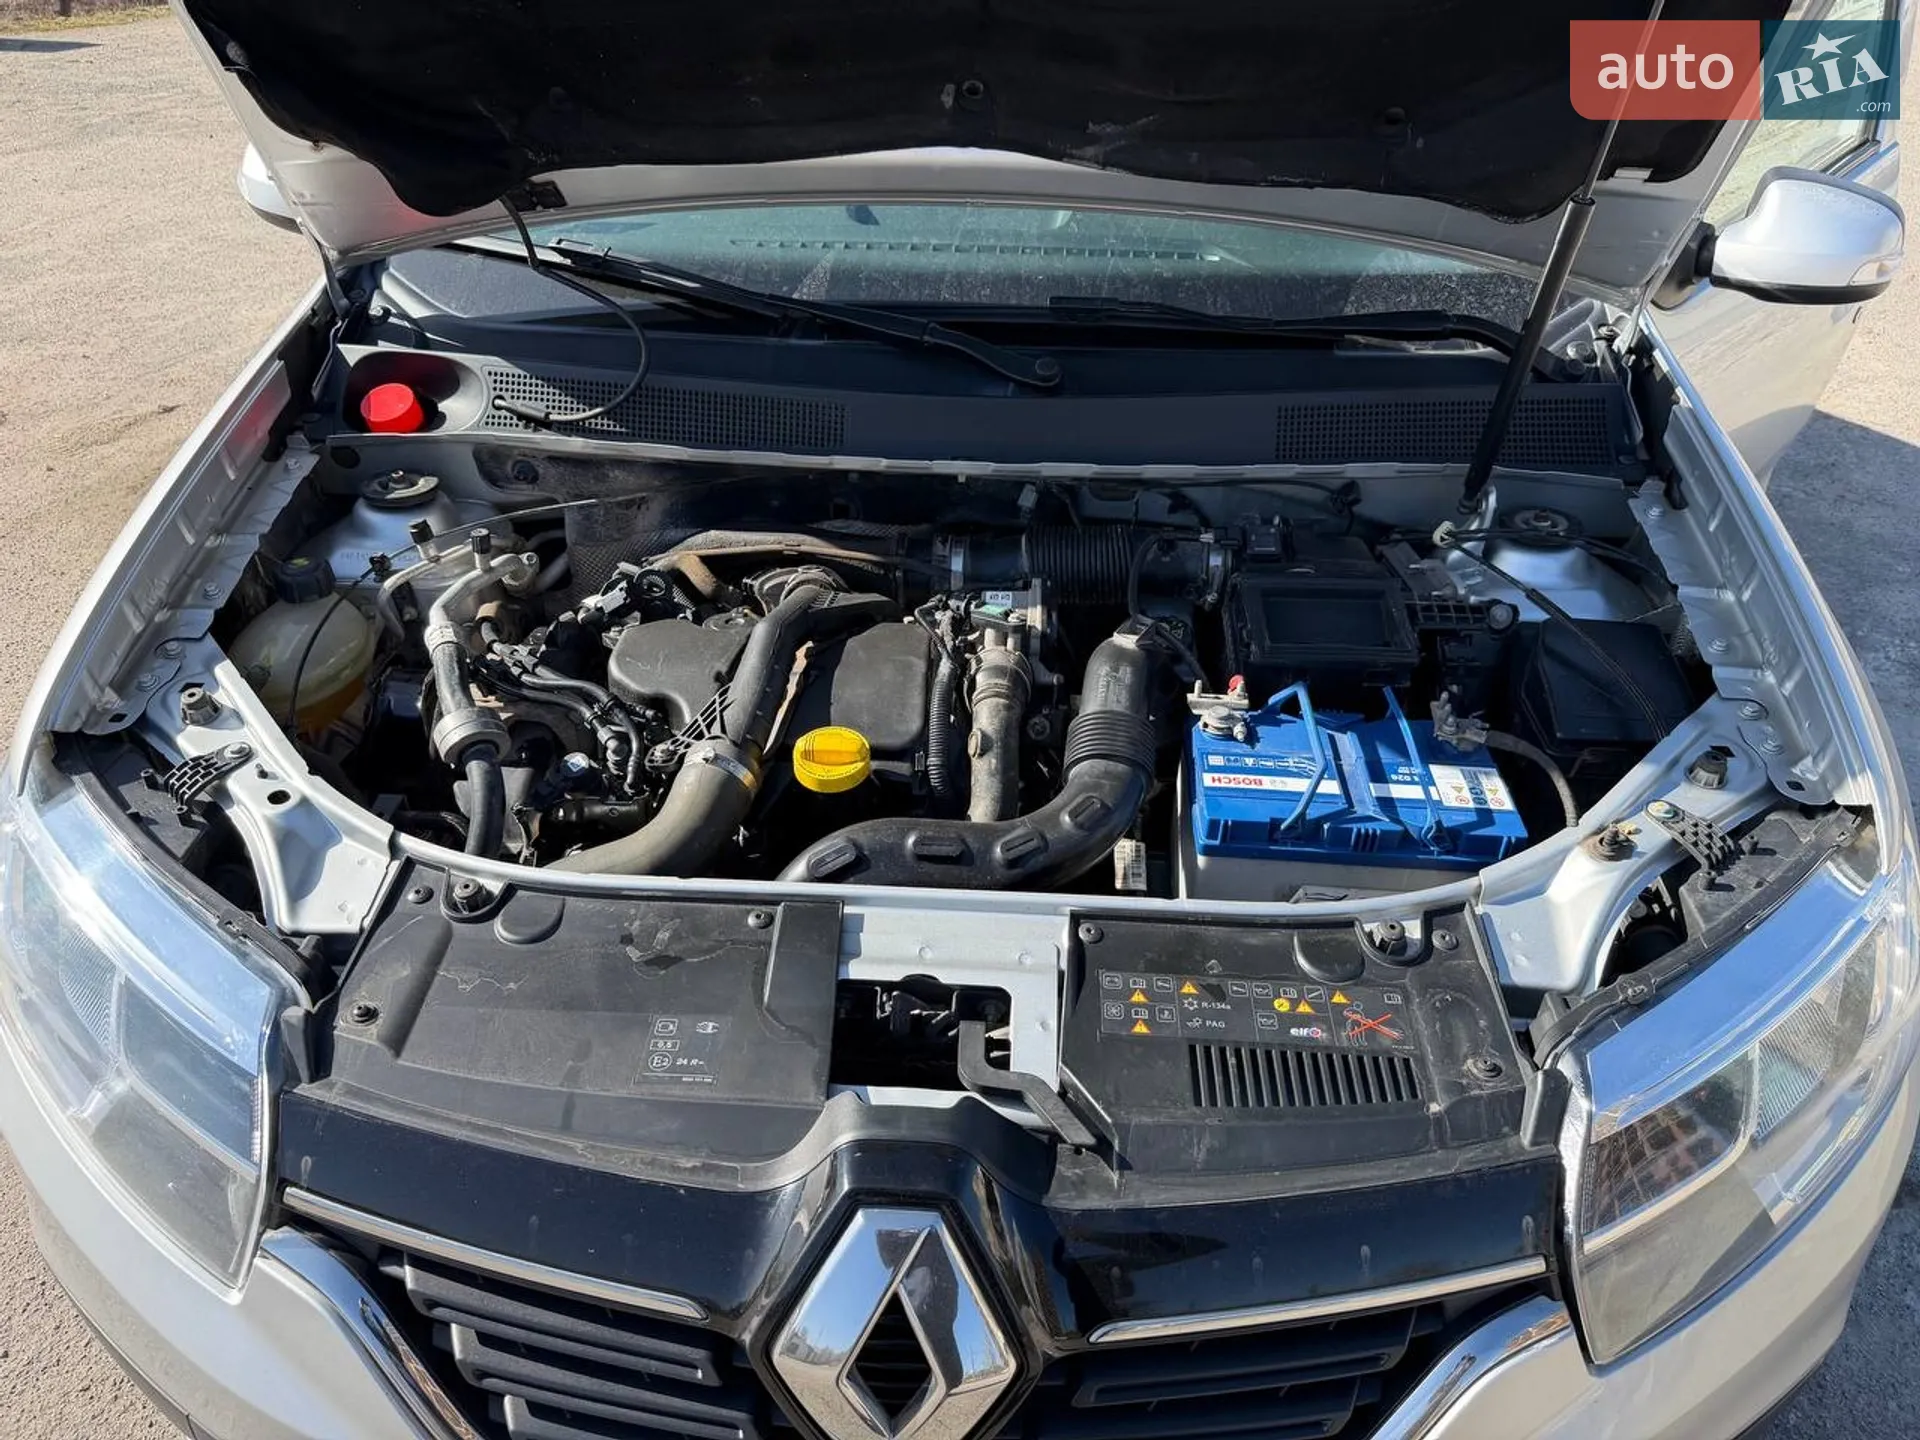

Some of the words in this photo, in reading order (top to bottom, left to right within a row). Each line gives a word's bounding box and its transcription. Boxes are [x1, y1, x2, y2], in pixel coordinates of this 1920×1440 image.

[1211, 776, 1263, 787] BOSCH
[1201, 1001, 1232, 1011] R-134a
[1205, 1020, 1226, 1029] PAG
